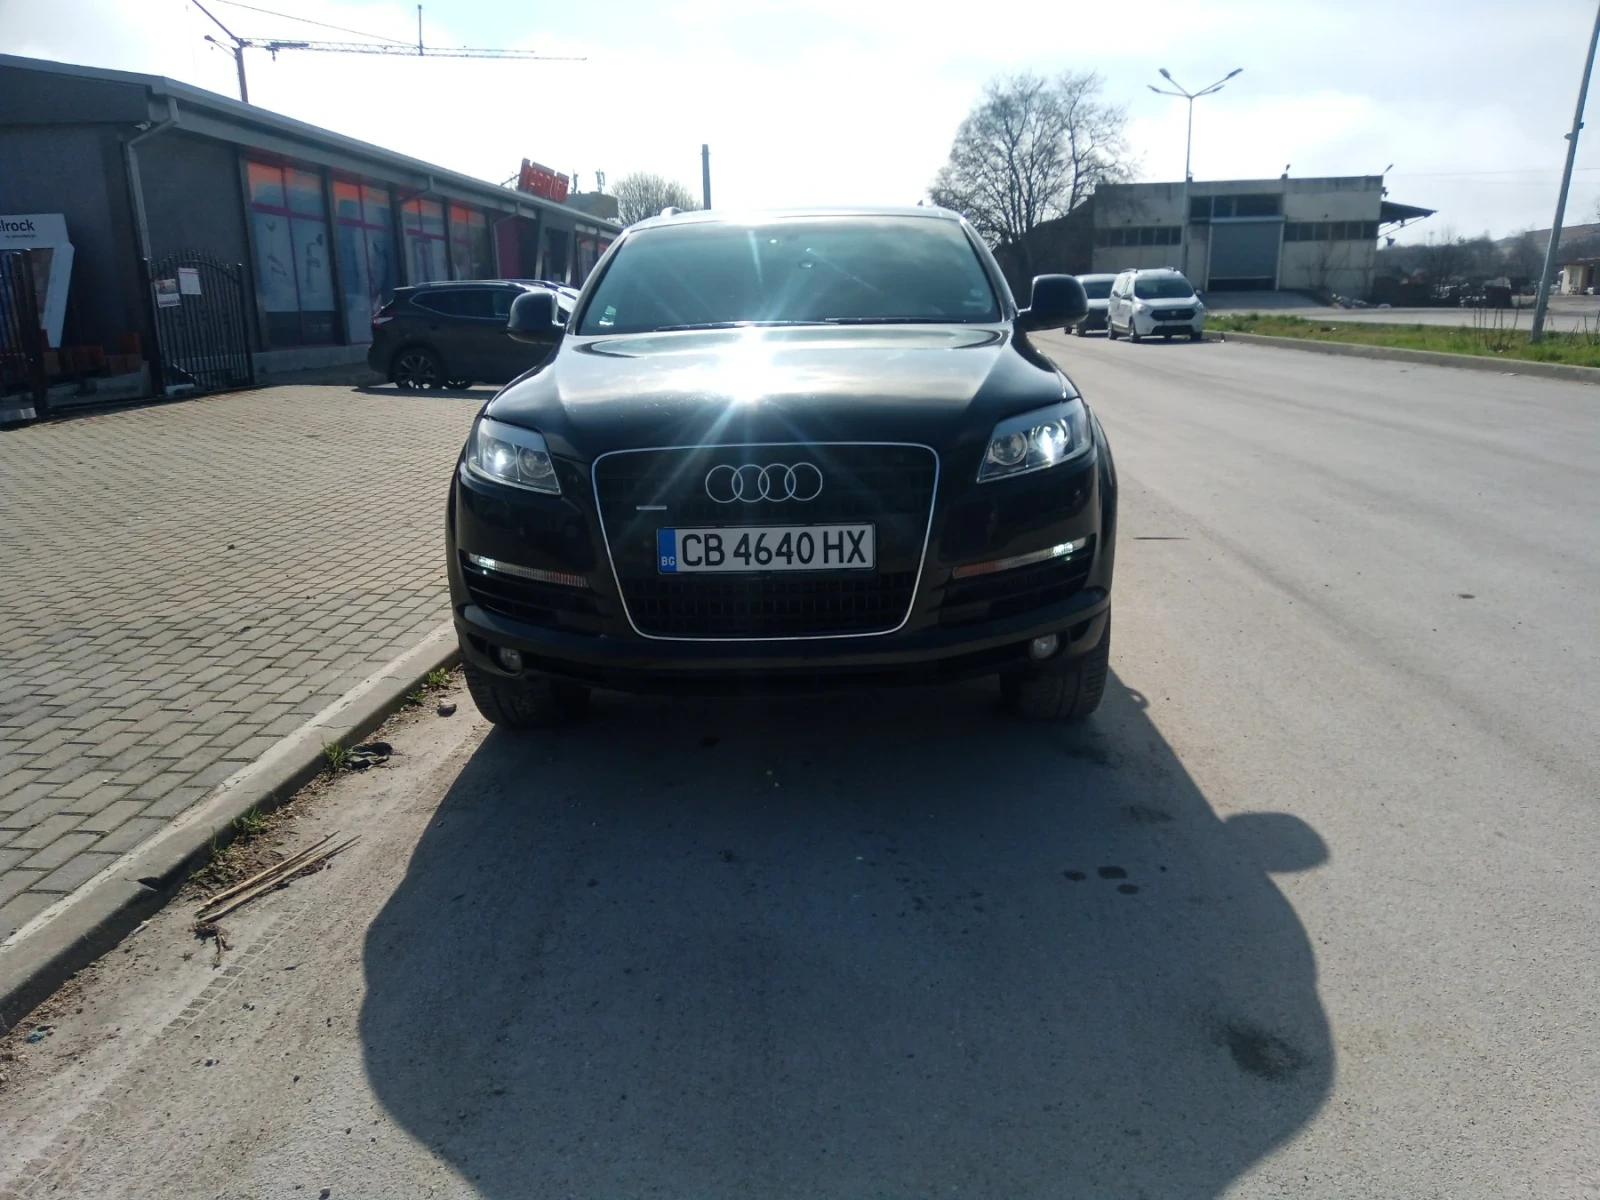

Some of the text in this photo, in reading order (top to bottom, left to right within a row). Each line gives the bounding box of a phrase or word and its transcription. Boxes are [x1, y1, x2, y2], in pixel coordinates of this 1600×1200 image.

[0, 219, 35, 231] lrock
[681, 530, 867, 567] CB 4640 HX
[661, 556, 675, 566] BG
